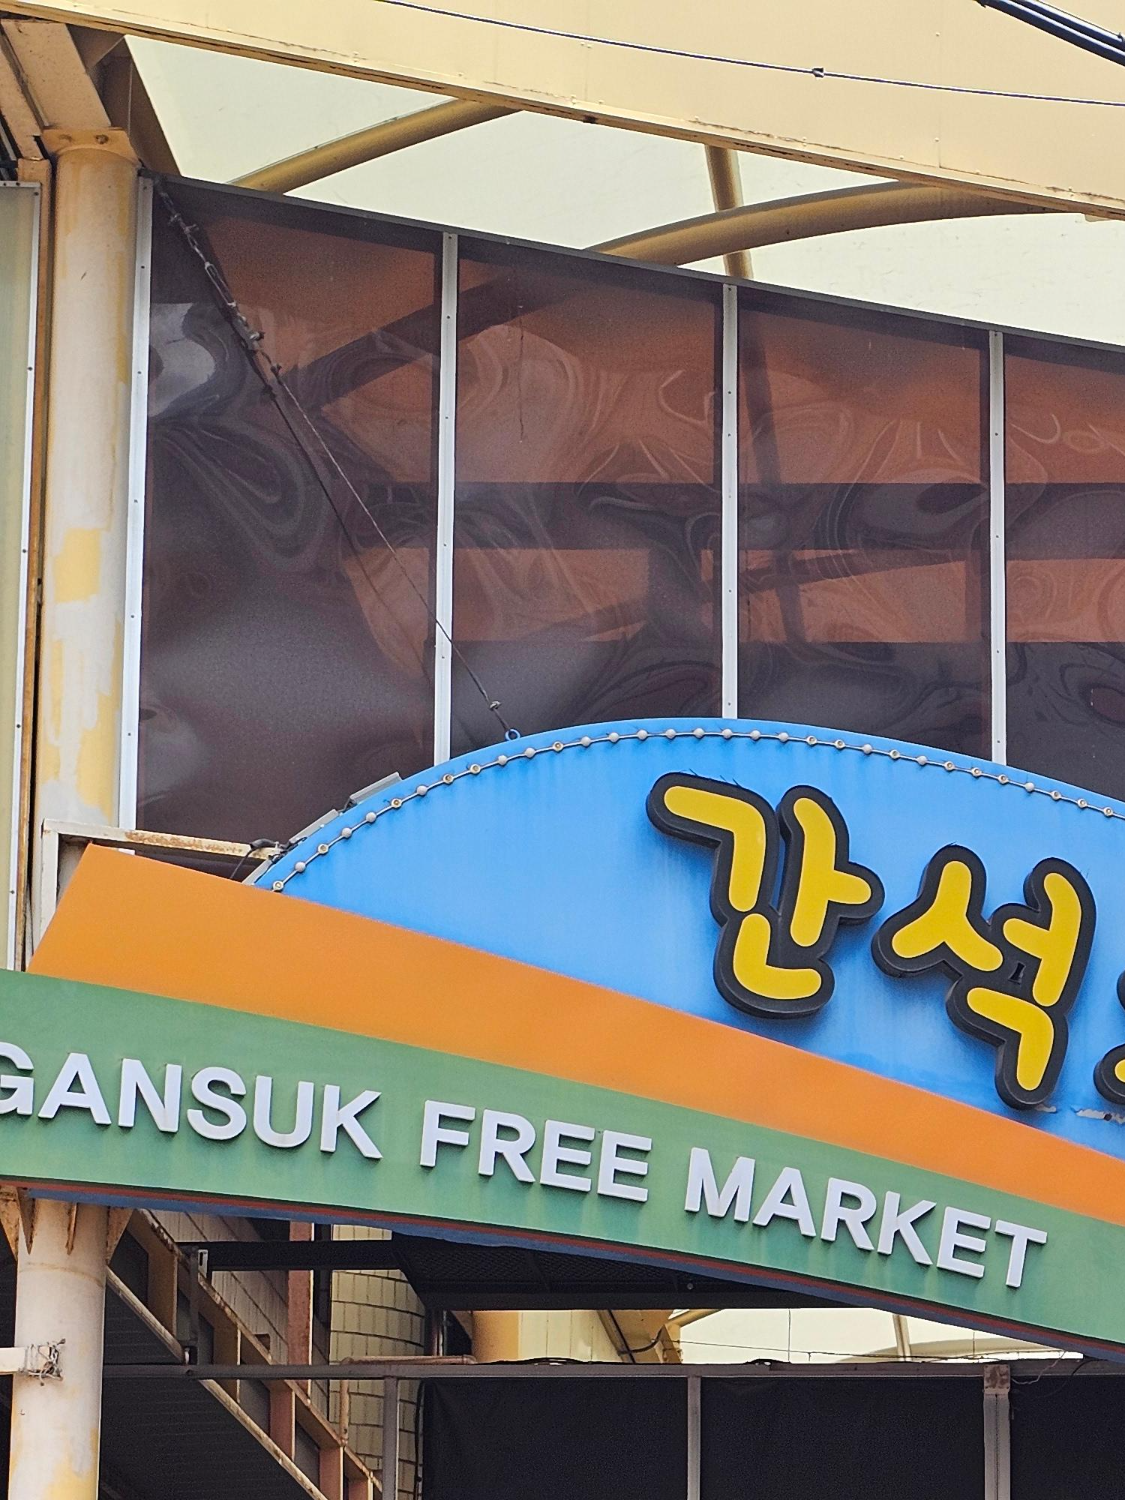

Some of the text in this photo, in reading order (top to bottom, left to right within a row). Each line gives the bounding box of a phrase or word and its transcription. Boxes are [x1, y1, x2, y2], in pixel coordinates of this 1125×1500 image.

[0, 1042, 1048, 1289] GANSUK FREE MARKET
